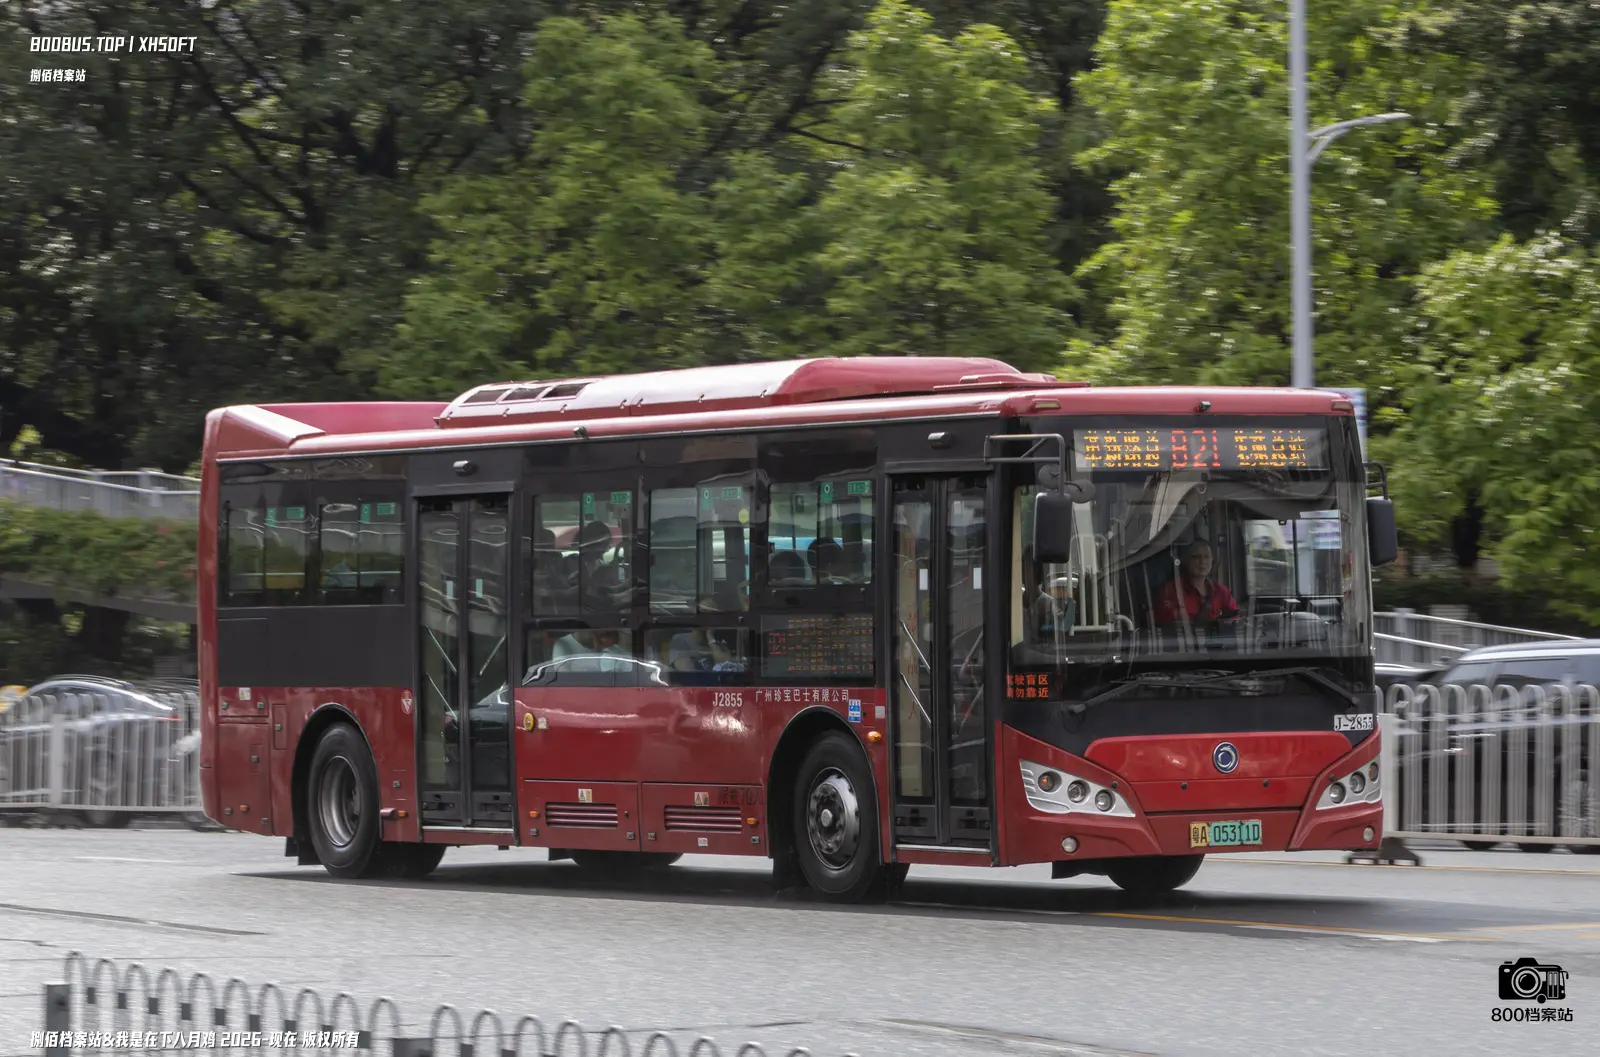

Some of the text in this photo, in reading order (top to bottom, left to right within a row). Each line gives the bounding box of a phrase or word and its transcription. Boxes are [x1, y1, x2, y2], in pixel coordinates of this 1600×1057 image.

[1171, 429, 1221, 467] 821
[712, 692, 743, 707] J2855
[755, 688, 850, 703] 广州珍宝巴士有限公司
[1334, 716, 1373, 731] J-2855
